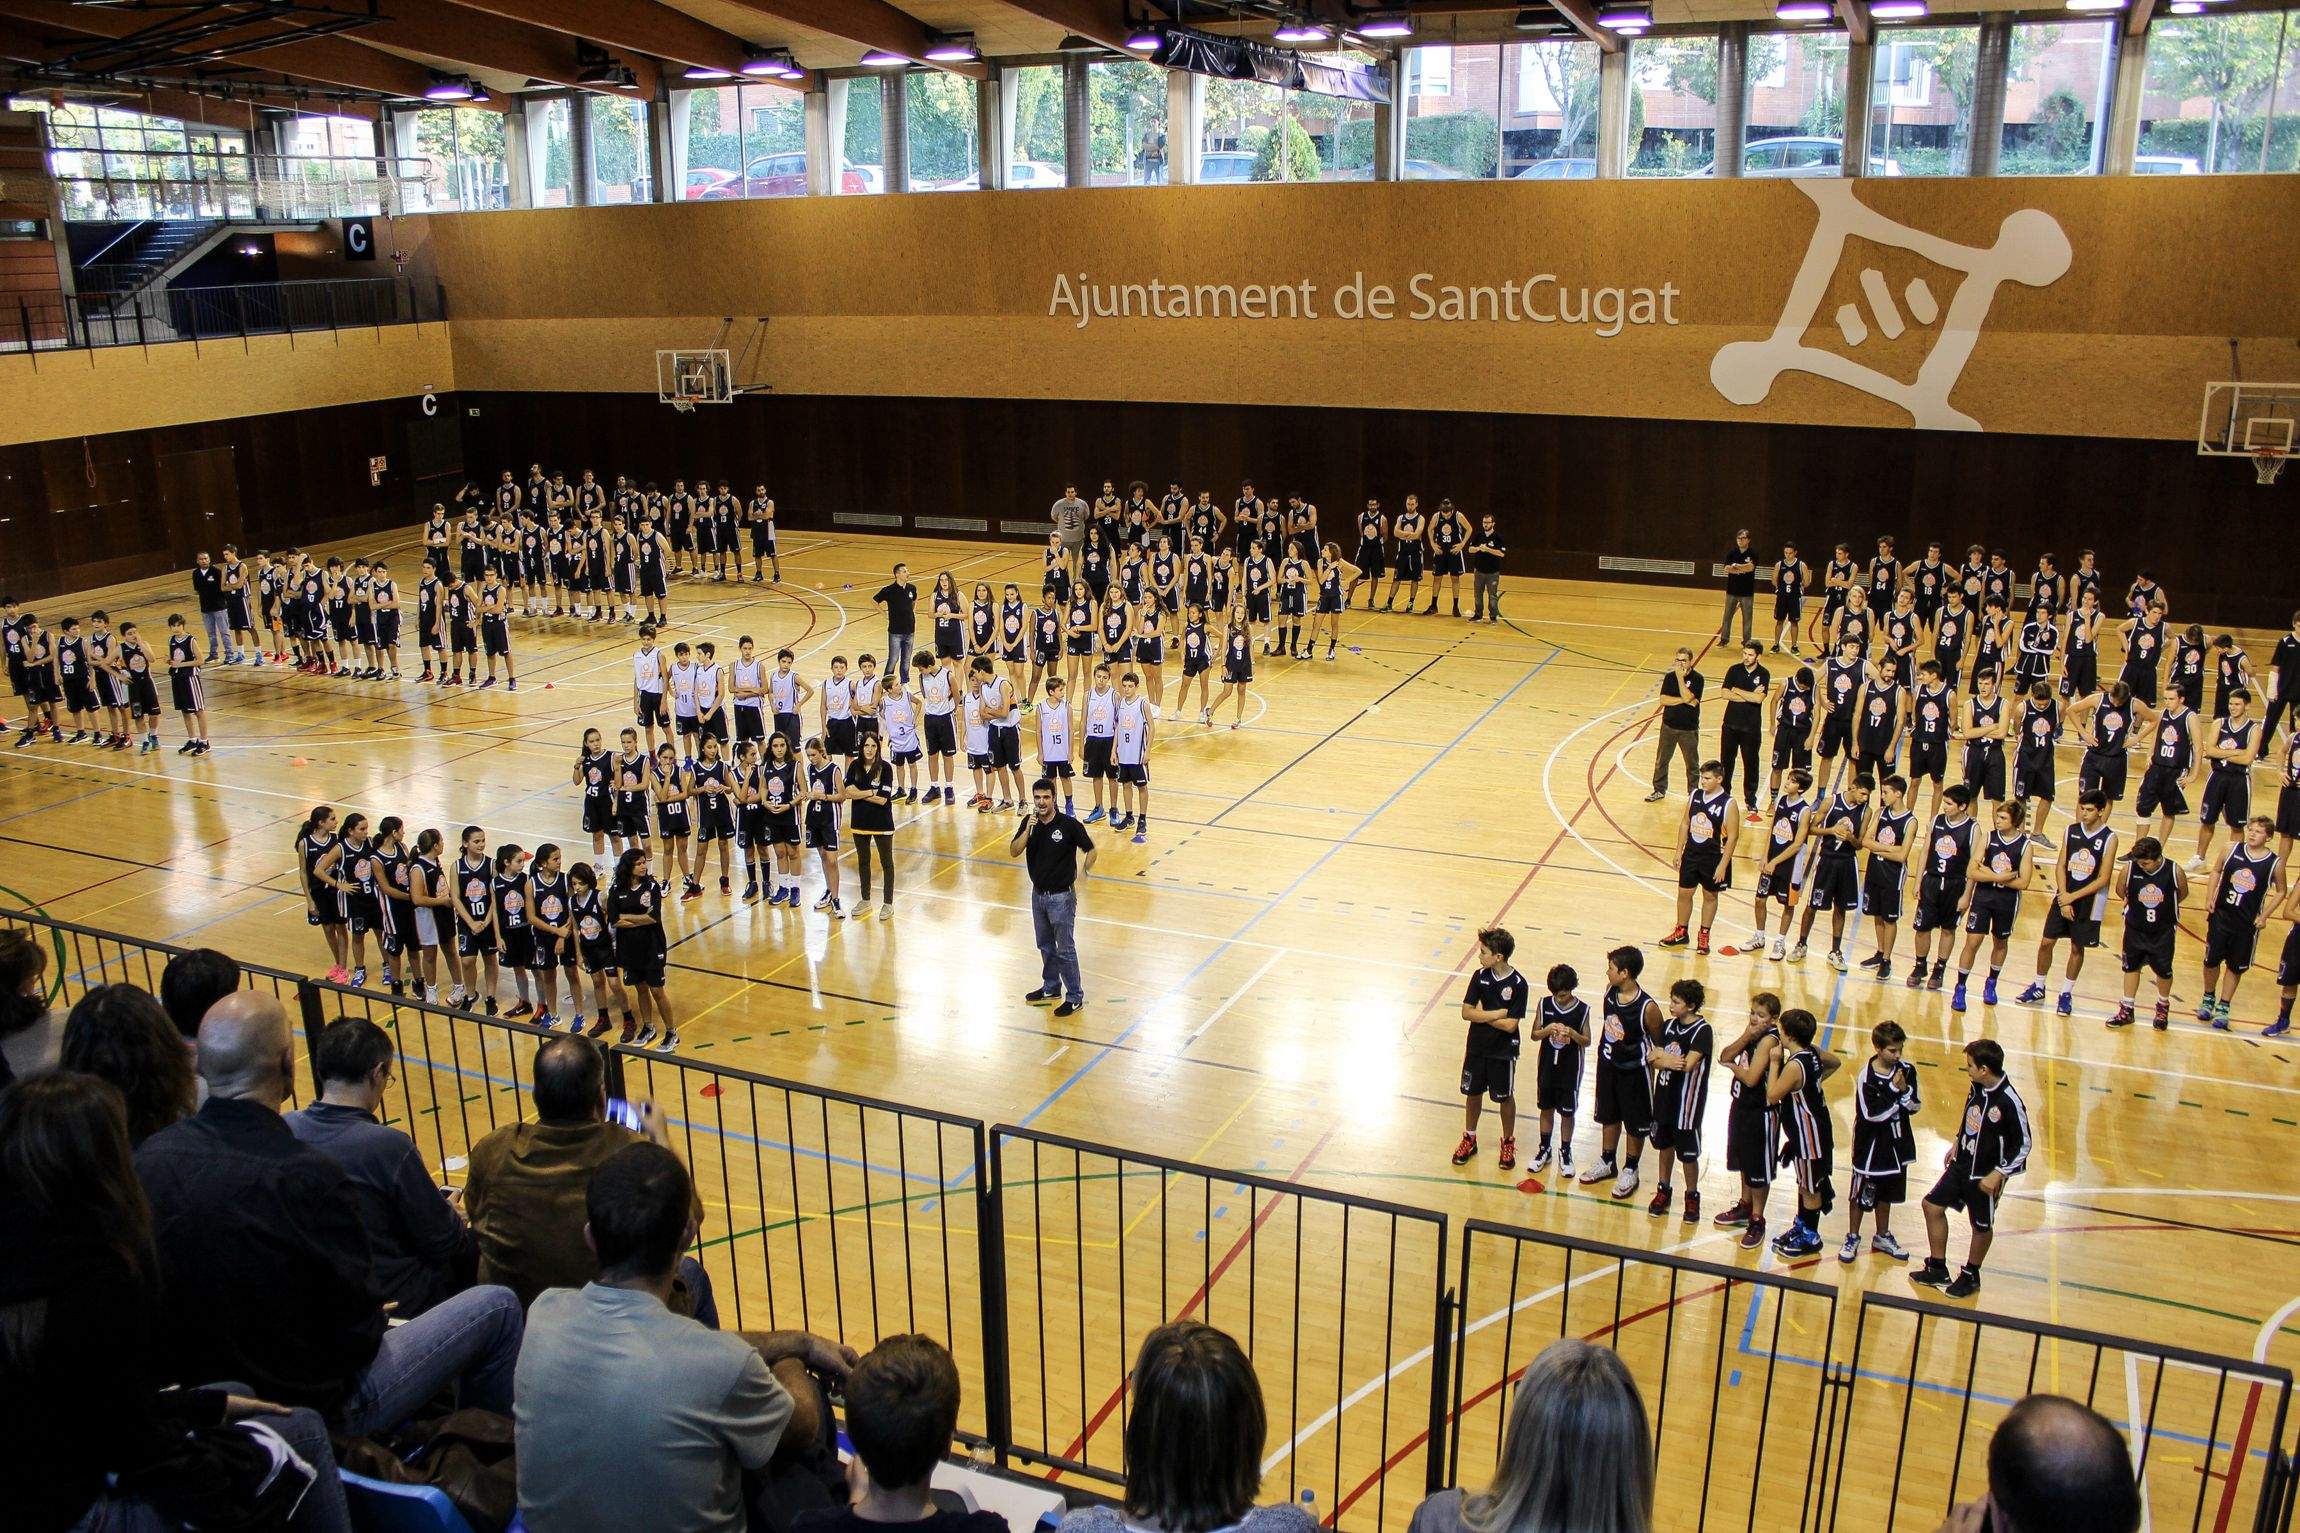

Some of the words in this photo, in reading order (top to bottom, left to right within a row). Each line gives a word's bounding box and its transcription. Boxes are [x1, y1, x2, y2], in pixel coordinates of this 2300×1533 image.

[350, 223, 366, 253] C
[1048, 272, 1317, 329] Ajuntament
[1333, 271, 1395, 321] de
[1408, 273, 1680, 338] SantCugat
[422, 393, 437, 416] C
[1198, 527, 1207, 535] 44
[1091, 563, 1097, 571] 2
[1053, 570, 1061, 579] 13
[1162, 576, 1167, 584] 5
[1193, 576, 1198, 584] 7
[1786, 584, 1792, 593] 6
[1876, 582, 1886, 590] 64
[1924, 586, 1933, 595] 18
[335, 600, 344, 609] 17
[939, 618, 949, 627] 22
[977, 625, 983, 635] 5
[1109, 628, 1118, 638] 21
[1045, 634, 1054, 644] 31
[1939, 636, 1952, 647] 24
[2076, 639, 2083, 649] 2
[1190, 649, 1198, 658] 17
[1983, 644, 1992, 654] 12
[1236, 650, 1242, 660] 9
[63, 665, 75, 674] 20
[2184, 664, 2198, 674] 30
[681, 694, 688, 703] 11
[1837, 693, 1845, 704] 5
[778, 701, 784, 711] 9
[1792, 715, 1797, 726] 1
[1870, 716, 1882, 727] 17
[899, 726, 906, 736] 3
[1093, 724, 1104, 734] 20
[1925, 721, 1936, 733] 13
[1052, 734, 1062, 745] 15
[1124, 733, 1131, 743] 8
[2035, 736, 2046, 747] 14
[2107, 731, 2115, 743] 7
[2160, 745, 2175, 758] 00
[586, 786, 600, 797] 45
[625, 791, 633, 803] 3
[667, 802, 682, 815] 00
[710, 798, 717, 810] 5
[1708, 804, 1723, 817] 44
[1790, 811, 1798, 822] 21
[1835, 840, 1843, 851] 7
[2093, 839, 2103, 850] 9
[1937, 859, 1947, 873] 3
[362, 881, 372, 894] 6
[2225, 890, 2243, 906] 31
[470, 902, 485, 916] 10
[592, 904, 598, 914] 4
[508, 915, 521, 927] 16
[2146, 909, 2156, 922] 8
[1602, 1043, 1613, 1060] 2
[1553, 1050, 1559, 1065] 1
[1731, 1080, 1741, 1098] 9
